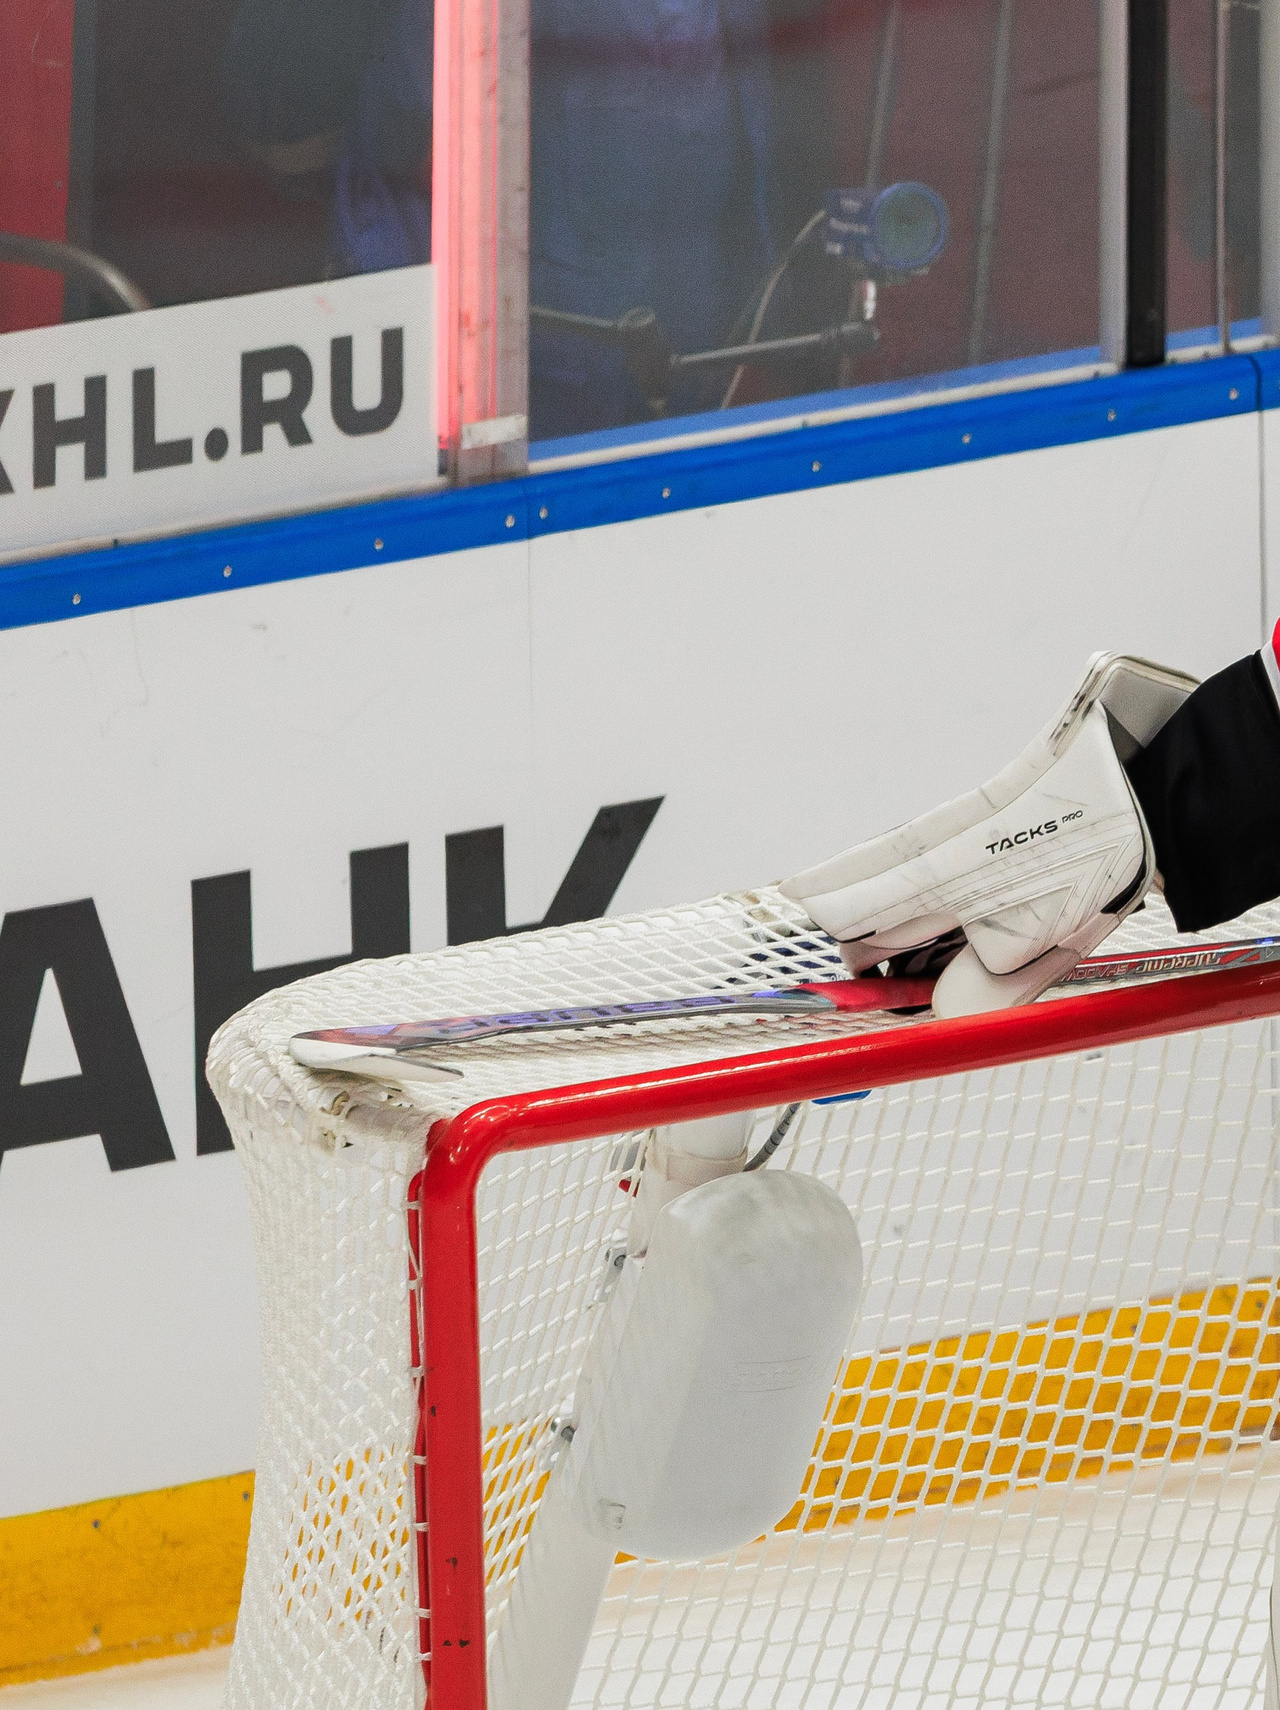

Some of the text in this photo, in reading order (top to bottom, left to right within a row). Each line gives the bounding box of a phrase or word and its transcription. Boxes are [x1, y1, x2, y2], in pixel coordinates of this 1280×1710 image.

[0, 326, 404, 495] HL.RU
[985, 810, 1084, 854] TACKS PRO
